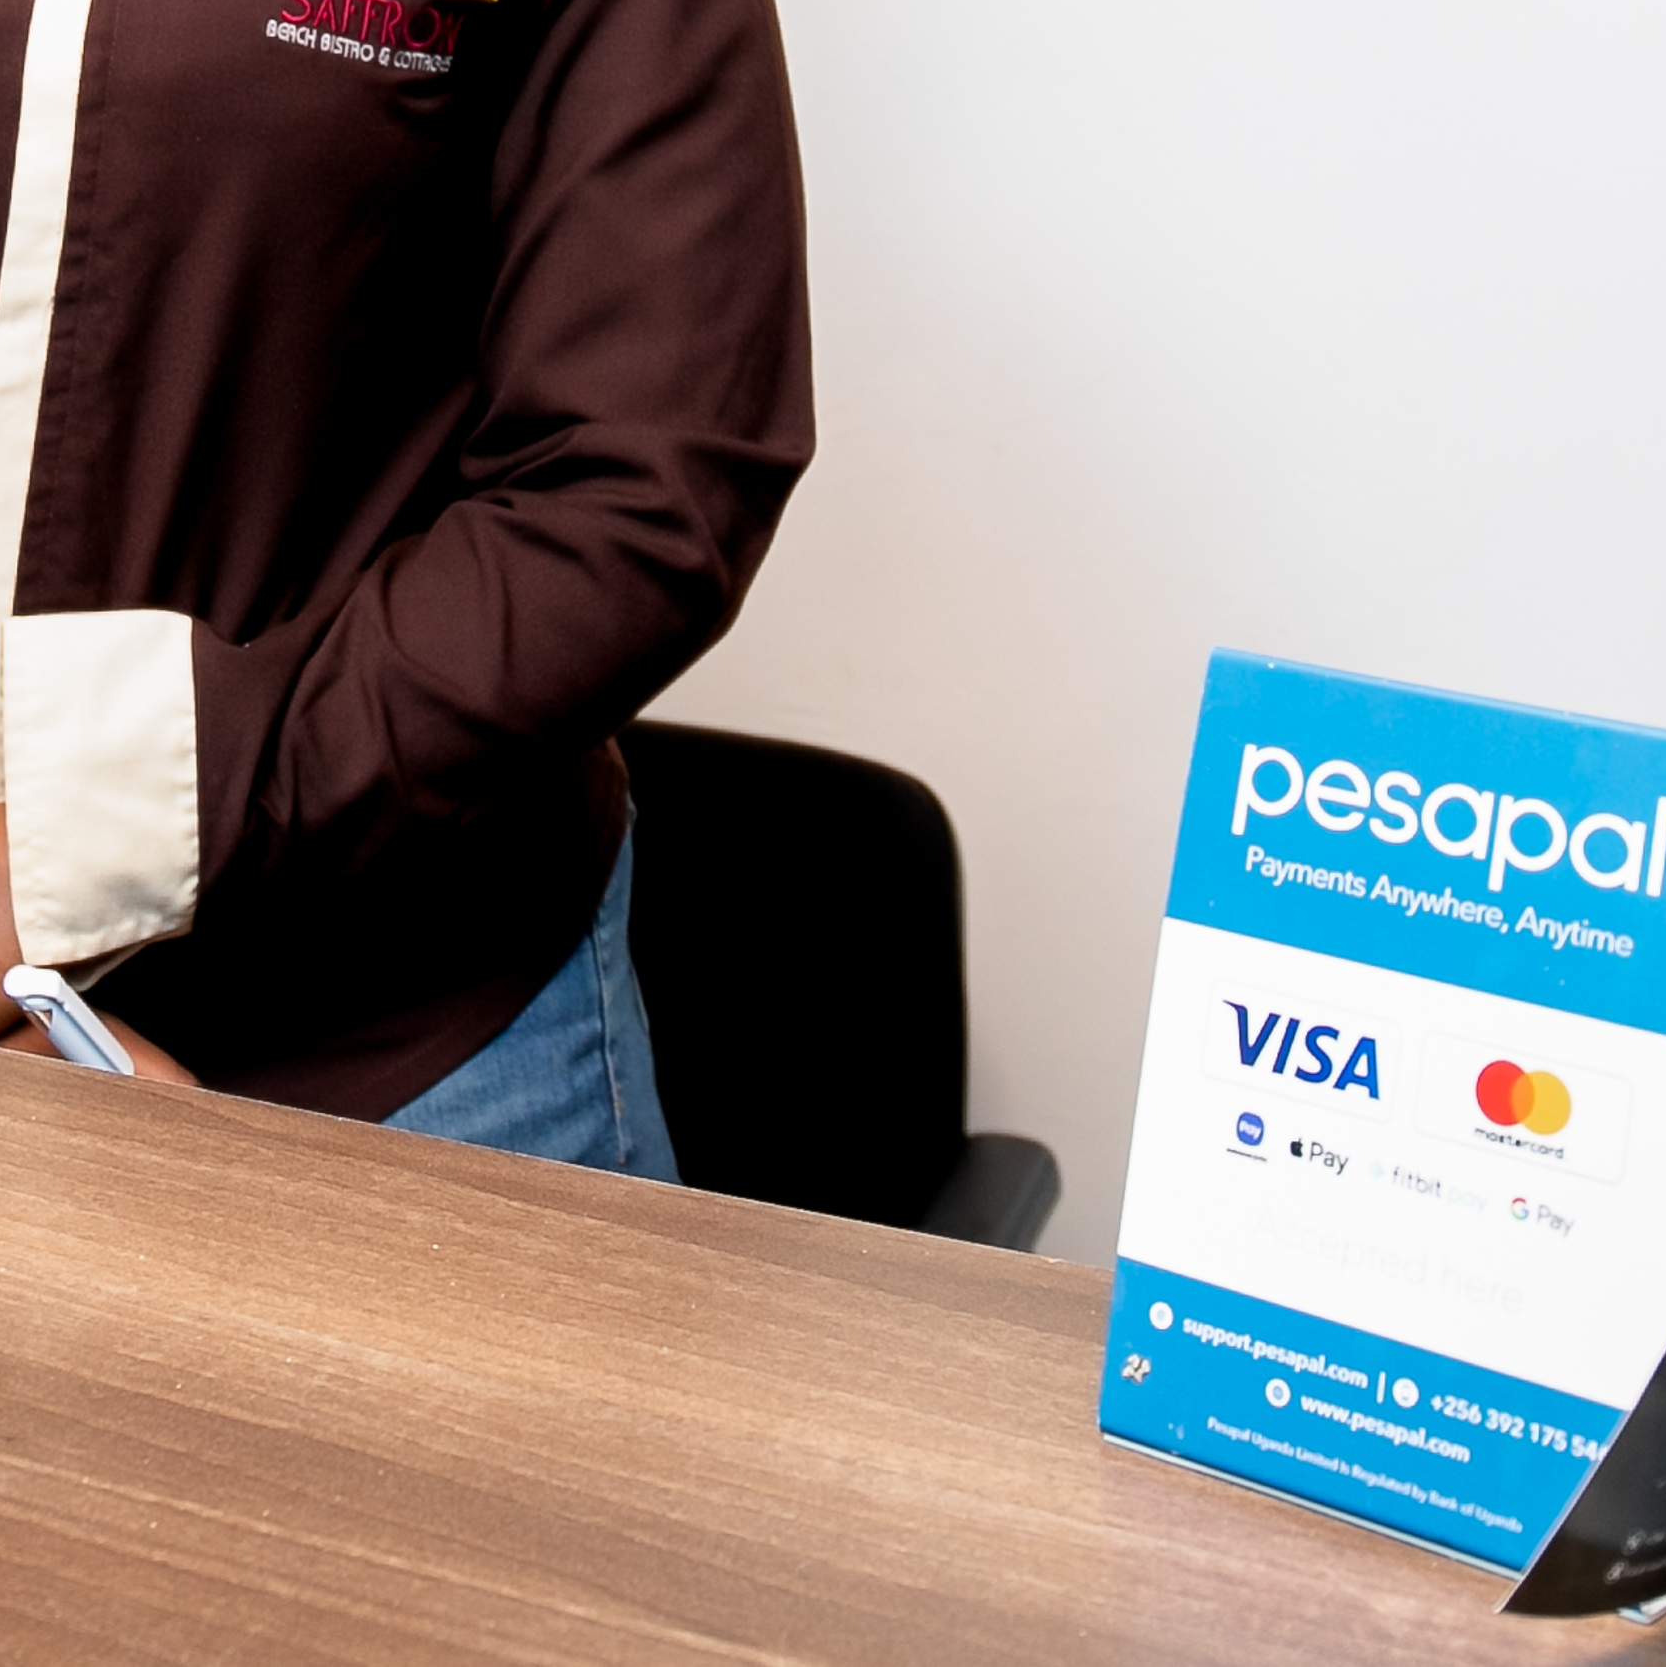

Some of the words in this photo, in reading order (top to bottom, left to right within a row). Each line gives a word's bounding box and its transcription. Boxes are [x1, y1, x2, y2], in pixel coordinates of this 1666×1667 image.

[320, 33, 375, 63] BISTRO
[1245, 844, 1367, 898] Payments
[1370, 874, 1510, 934] Anywhere,
[1515, 907, 1635, 959] Anytime
[1222, 999, 1380, 1100] VISA
[1310, 1141, 1349, 1175] Pay
[1474, 1126, 1566, 1161] mastercard
[1182, 1315, 1369, 1389] support.pesapal.com
[1431, 1393, 1482, 1426] +256
[1484, 1406, 1525, 1441] 392
[1529, 1420, 1568, 1452] 175
[1300, 1393, 1471, 1463] www.pesapal.com
